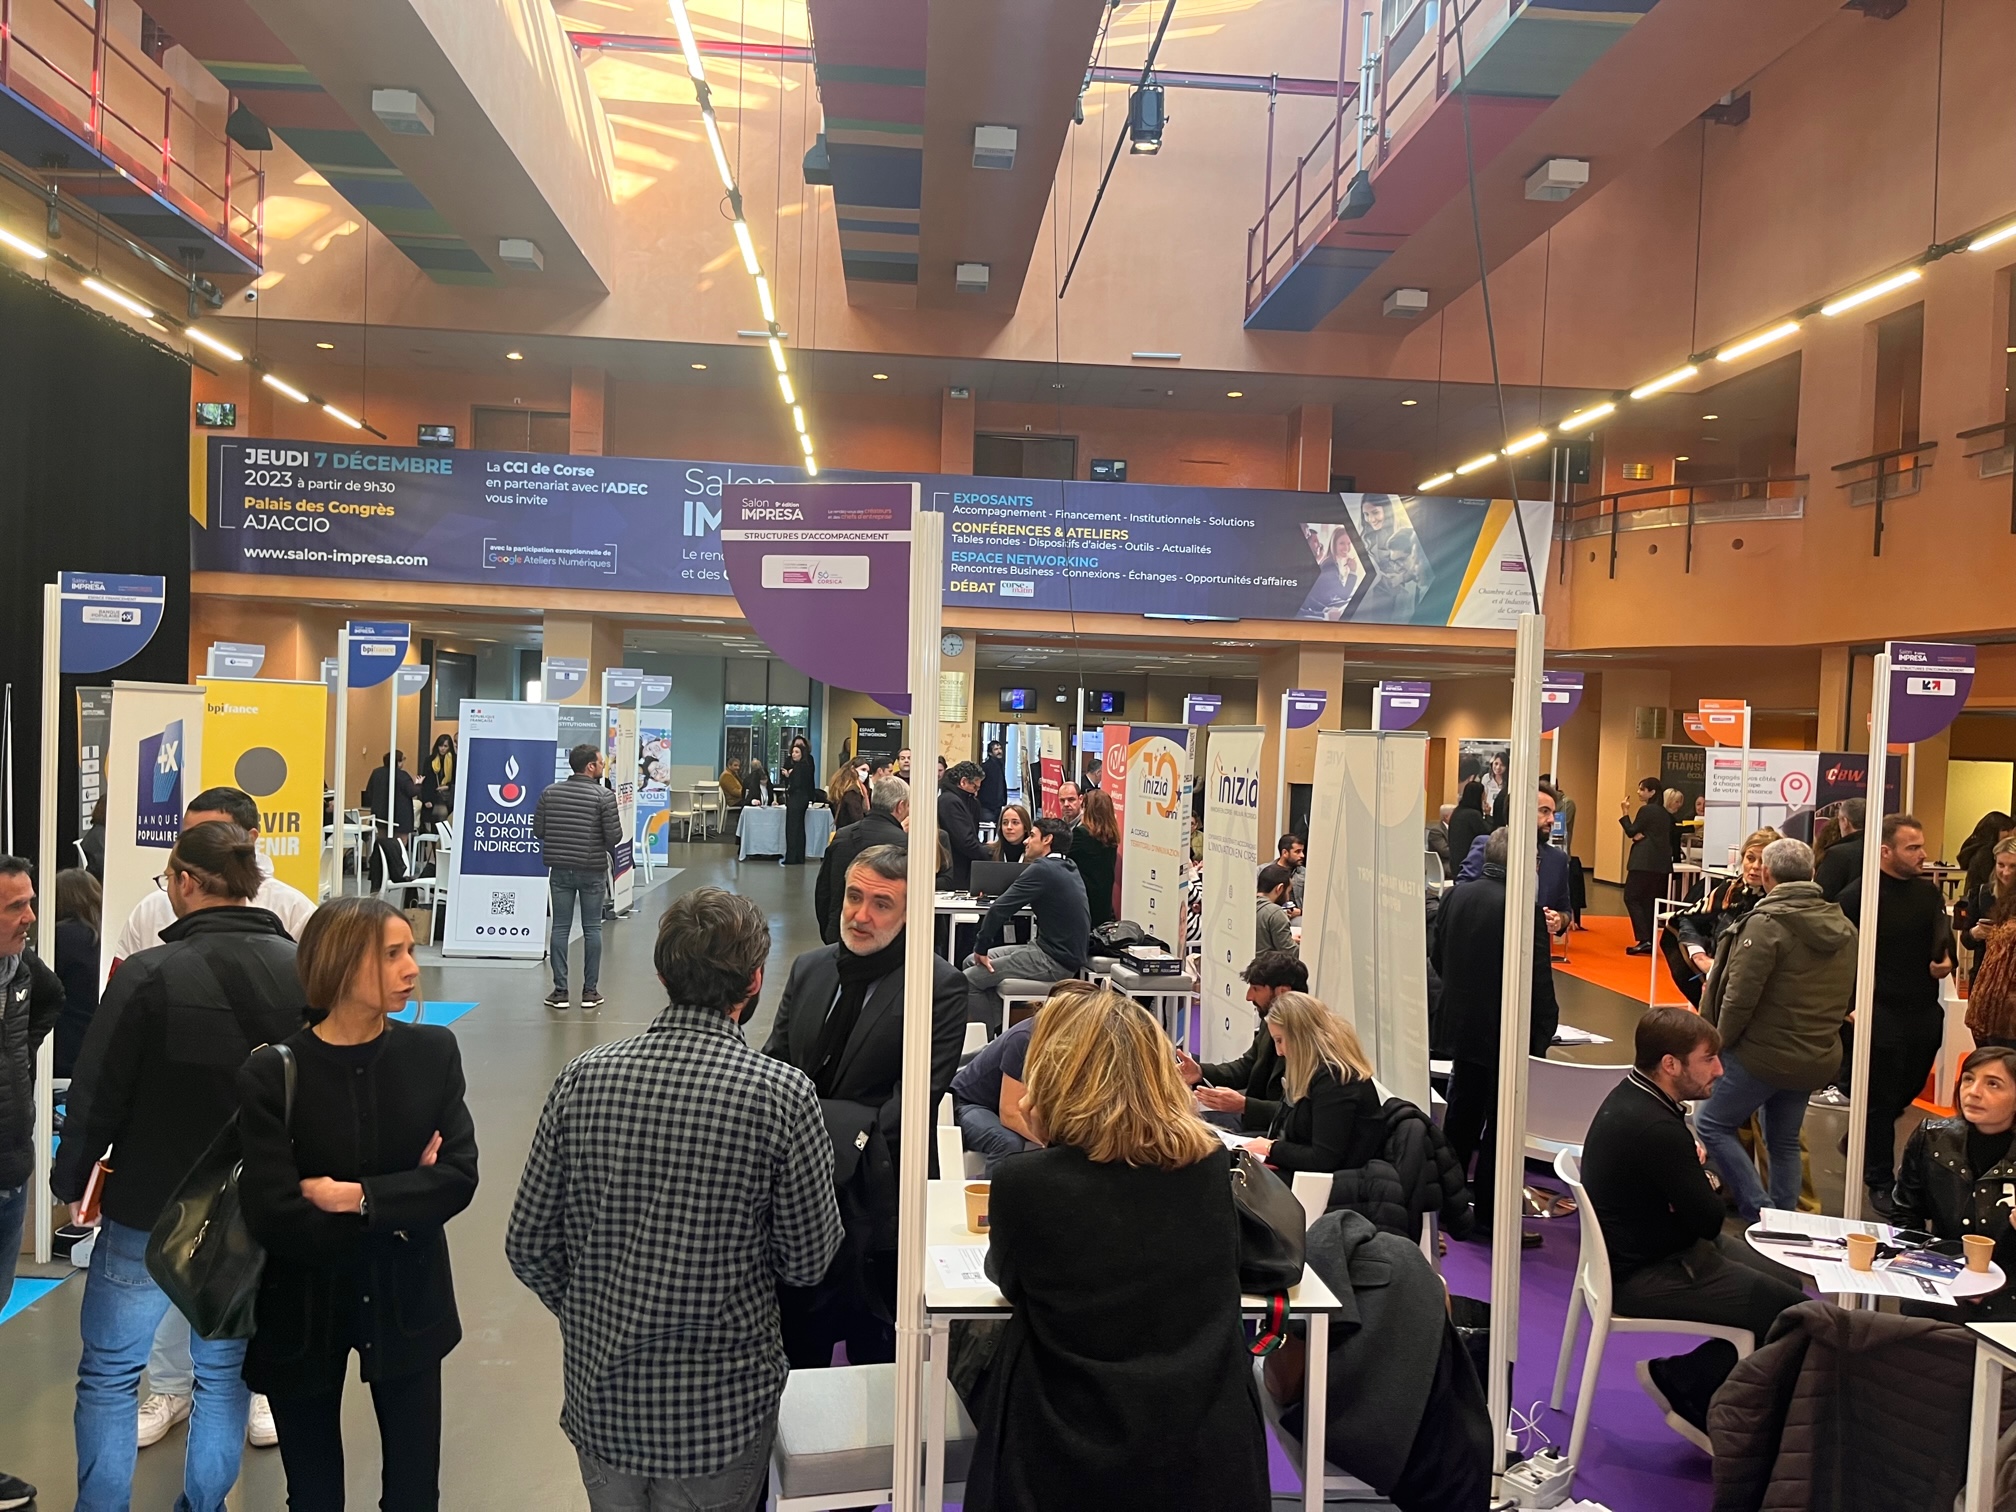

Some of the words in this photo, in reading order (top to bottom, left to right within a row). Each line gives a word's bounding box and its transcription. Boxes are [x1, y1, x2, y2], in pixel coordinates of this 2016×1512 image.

[244, 448, 309, 467] JEUDI
[314, 452, 328, 468] 7
[333, 451, 453, 475] DÉCEMBRE
[486, 462, 500, 472] La
[502, 461, 528, 474] CCI
[531, 463, 550, 475] de
[553, 464, 595, 477] Corse
[244, 470, 293, 487] 2023
[297, 477, 305, 488] à
[308, 479, 342, 492] partir
[344, 480, 361, 491] de
[363, 481, 396, 493] 9h30
[485, 479, 501, 488] en
[504, 479, 569, 491] partenariat
[571, 482, 598, 493] avec
[601, 481, 649, 495] l'ADEC
[244, 496, 292, 511] Palais
[295, 499, 325, 512] des
[328, 501, 395, 517] Congrès
[485, 494, 513, 504] vous
[515, 494, 548, 505] invite
[741, 498, 769, 508] Salon
[953, 492, 1034, 508] EXPOSANTS
[741, 508, 804, 521] IMPRESA
[952, 505, 1046, 519] Accompagnement
[1055, 509, 1121, 522] Financement
[1129, 513, 1201, 526] Institutionnels
[1208, 516, 1255, 528] Solutions
[243, 514, 330, 533] AJACCIO
[952, 521, 1051, 537] CONFÉRENCES
[1054, 526, 1064, 538] &
[1066, 526, 1129, 540] ATELIERS
[744, 532, 799, 540] STRUCTURES
[801, 532, 889, 541] D'ACCOMPAGNEMENT
[513, 545, 554, 554] participation
[555, 547, 602, 556] exceptionnelle
[951, 534, 984, 545] Tables
[986, 536, 1020, 547] rondes
[1081, 539, 1117, 550] d'aides
[1124, 541, 1154, 552] Outils
[1162, 543, 1212, 555] Actualités
[244, 547, 428, 566] www.salon-impresa.com
[488, 552, 522, 566] Google
[523, 555, 557, 566] Ateliers
[558, 557, 611, 569] Numériques
[682, 548, 697, 559] Le
[951, 551, 1003, 564] ESPACE
[1006, 553, 1099, 568] NETWORKING
[681, 568, 695, 579] et
[697, 569, 720, 580] des
[950, 563, 1008, 575] Rencontres
[1010, 566, 1054, 577] Business
[1062, 568, 1121, 580] Connexions
[1128, 569, 1177, 584] Échanges
[1185, 572, 1252, 587] Opportunités
[1253, 575, 1298, 588] d'affaires
[71, 583, 106, 591] IMPRESA
[950, 580, 996, 594] DÉBAT
[1478, 587, 1505, 595] Chambre
[362, 645, 394, 654] bpifrance
[1898, 654, 1928, 662] IMPRESA
[207, 703, 259, 716] bpifrance
[1713, 773, 1740, 781] Engagés
[1826, 767, 1865, 782] CBW
[1142, 775, 1168, 796] inizià
[1218, 765, 1259, 808] inizià
[138, 813, 178, 825] BANQUE
[475, 812, 534, 826] DOUANE
[1165, 810, 1177, 820] anni
[137, 830, 178, 842] POPULAIRE
[474, 827, 485, 838] &
[490, 827, 538, 839] DROIT
[473, 840, 540, 854] INDIRECTS
